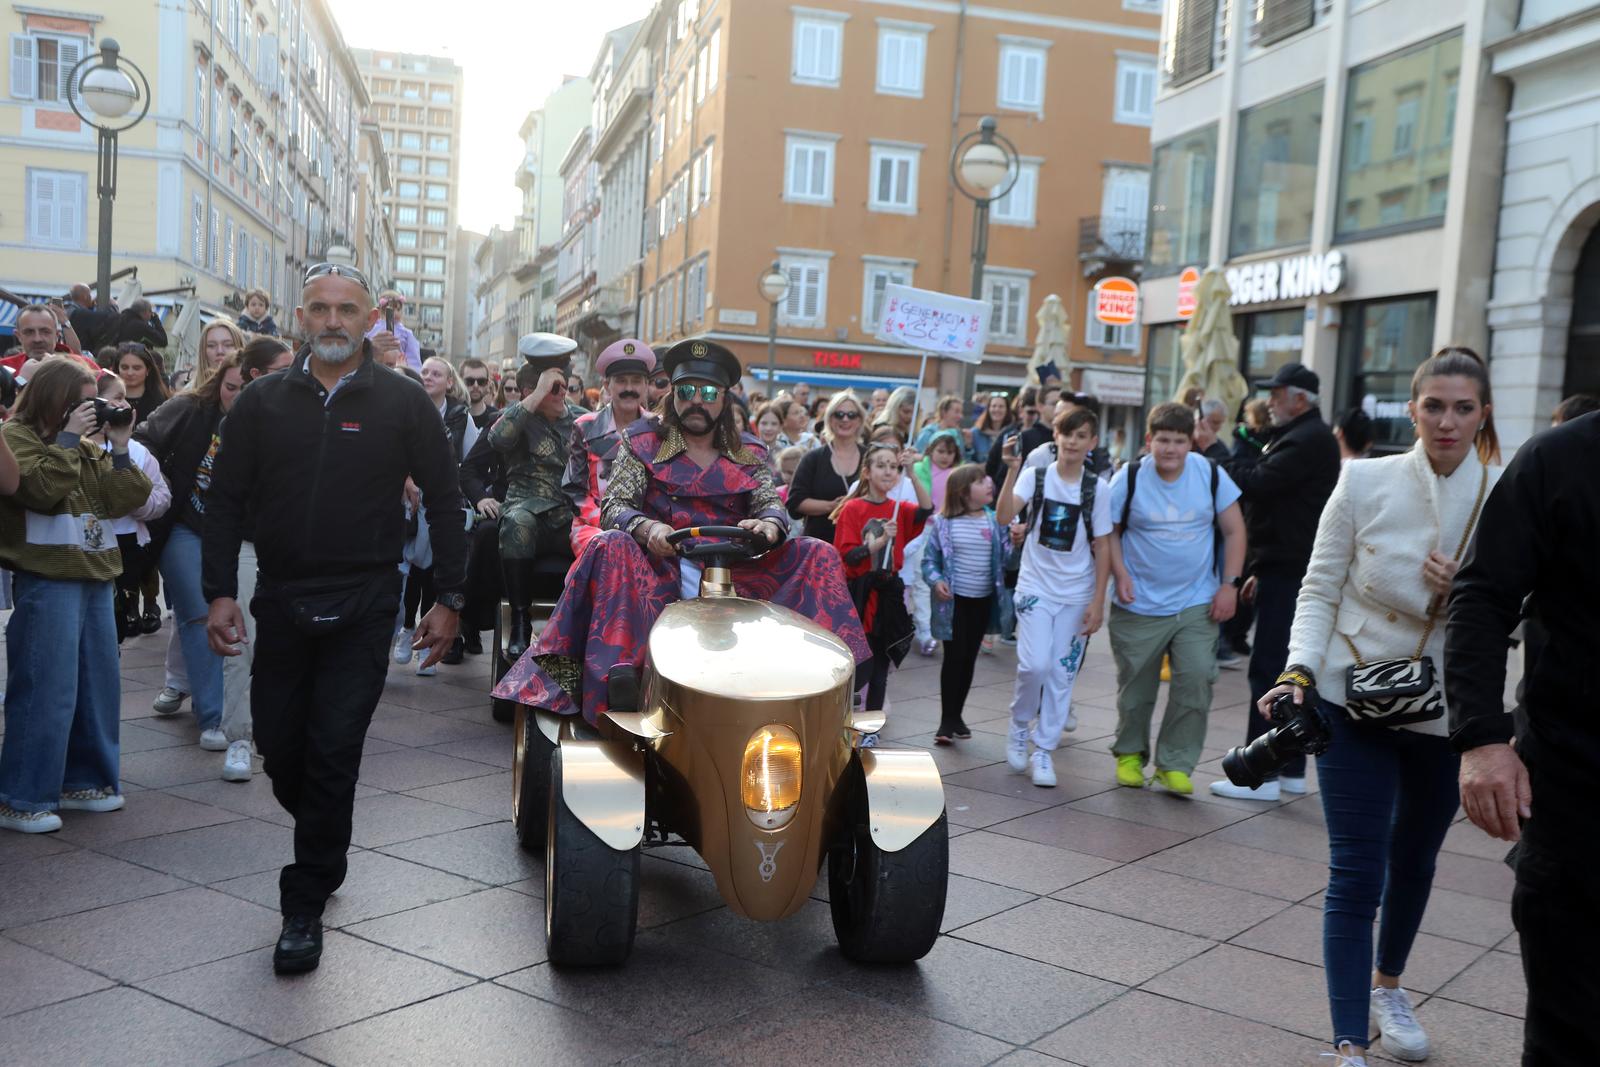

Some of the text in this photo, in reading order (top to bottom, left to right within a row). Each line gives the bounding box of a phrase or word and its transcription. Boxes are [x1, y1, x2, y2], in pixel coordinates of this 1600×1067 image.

[1281, 250, 1342, 300] KING
[1099, 303, 1134, 315] KING
[812, 351, 864, 369] TISAK
